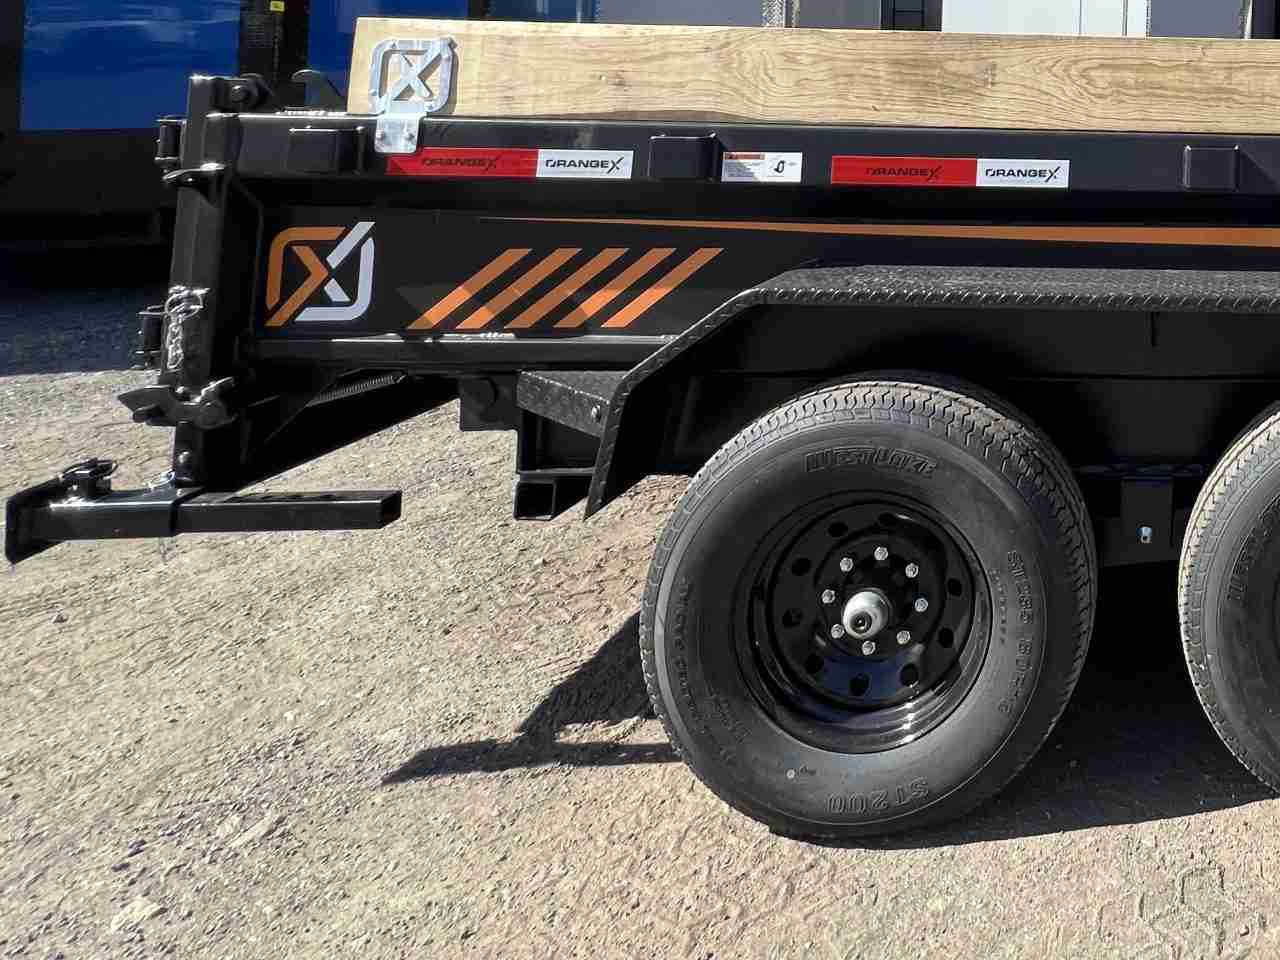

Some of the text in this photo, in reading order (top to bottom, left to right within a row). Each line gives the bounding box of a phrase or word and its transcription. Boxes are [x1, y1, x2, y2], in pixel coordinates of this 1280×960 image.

[545, 157, 625, 174] ORANGEX
[866, 165, 943, 182] ORANGEX
[985, 166, 1061, 183] ORANGEX
